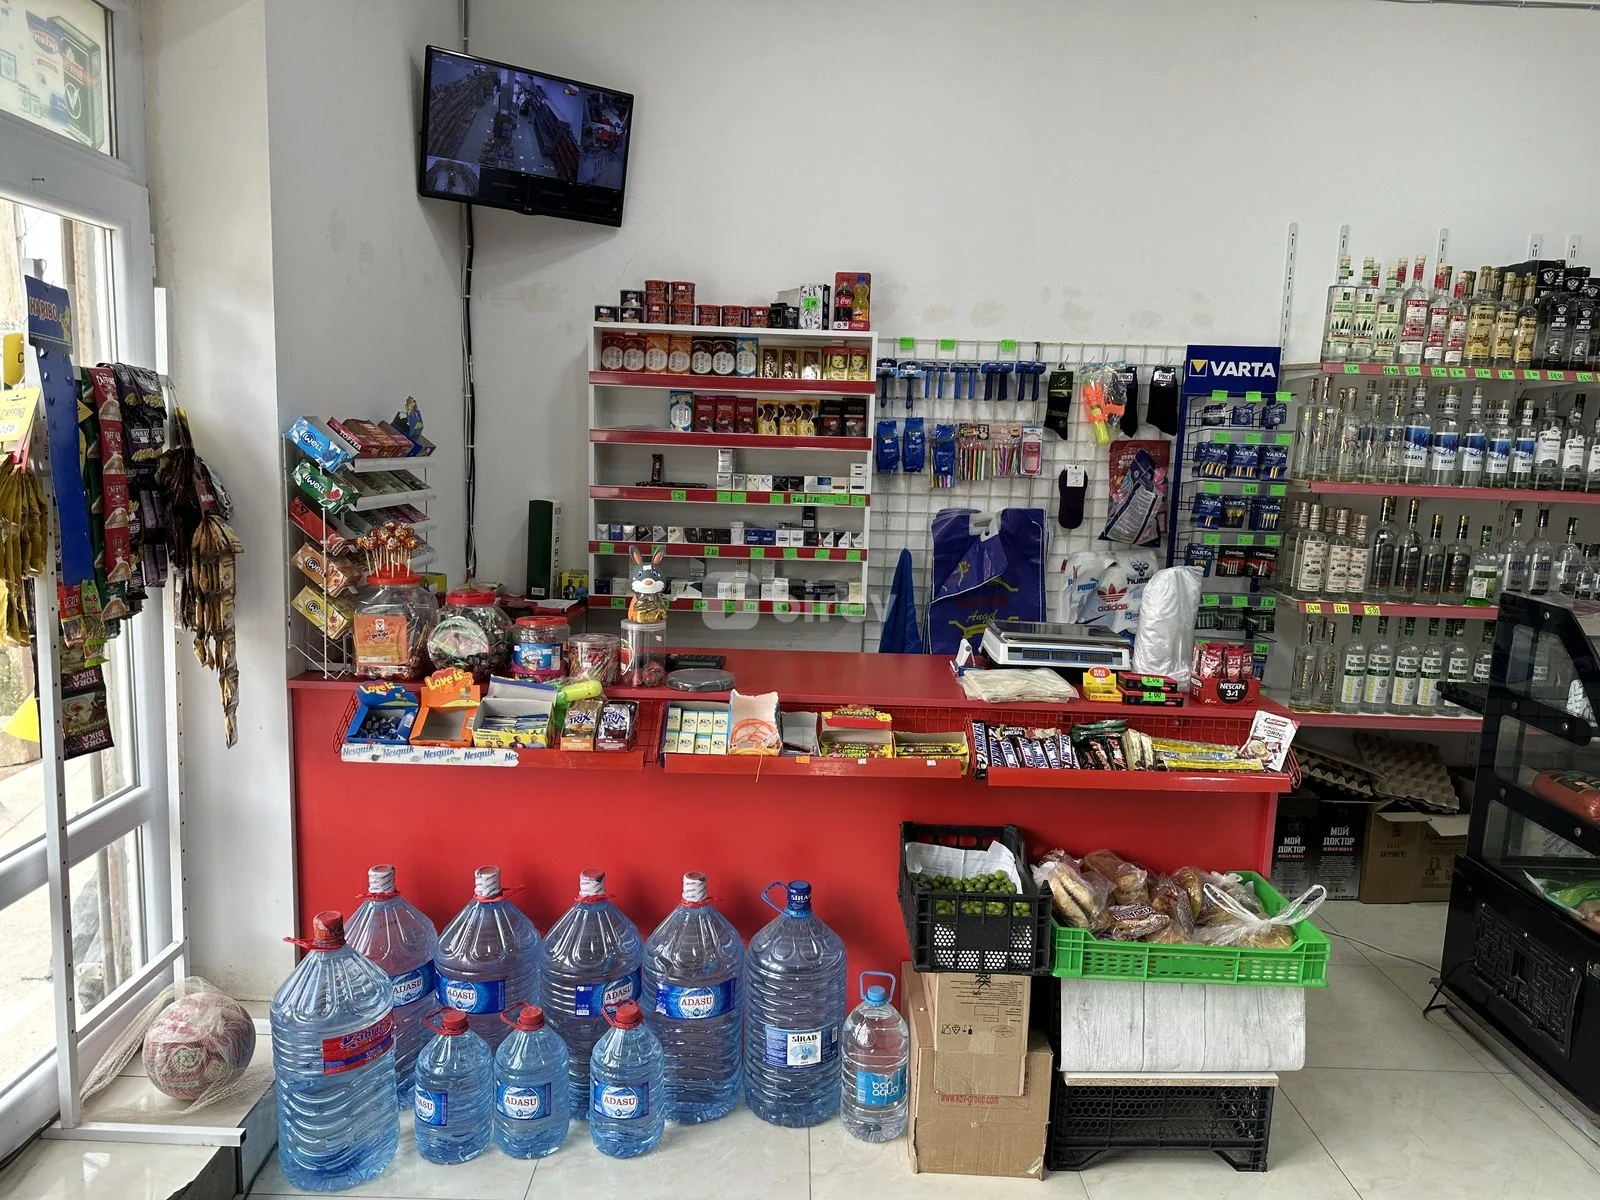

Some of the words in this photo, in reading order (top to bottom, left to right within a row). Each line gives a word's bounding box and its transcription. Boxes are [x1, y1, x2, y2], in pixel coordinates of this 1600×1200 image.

[29, 296, 58, 323] HARIBO
[1210, 361, 1276, 378] VARTA
[1097, 602, 1128, 612] adidas
[966, 609, 998, 624] Angel
[72, 669, 95, 680] BIKA
[73, 675, 98, 688] TORA
[425, 674, 453, 691] Love
[359, 683, 386, 695] Love
[570, 713, 591, 724] TRIX
[603, 711, 625, 724] TRIX
[81, 729, 105, 742] BIKA
[82, 735, 108, 749] TORA
[343, 744, 374, 757] Nesquik
[383, 745, 415, 759] Nesquik
[423, 748, 455, 760] Nesquik
[464, 749, 496, 761] Nesquik
[1330, 825, 1350, 836] МОЙ
[1284, 835, 1301, 845] МОЙ
[1322, 837, 1355, 846] ДОКТОР
[1277, 845, 1306, 854] ДОКТОР
[393, 979, 422, 995] ADASU
[605, 984, 632, 1002] ADASU
[447, 989, 475, 1001] ADASU
[680, 996, 713, 1006] ADASU
[791, 1034, 818, 1043] SİRAB
[872, 1081, 893, 1090] bon
[505, 1096, 536, 1107] ADASU
[604, 1096, 635, 1106] ADASU
